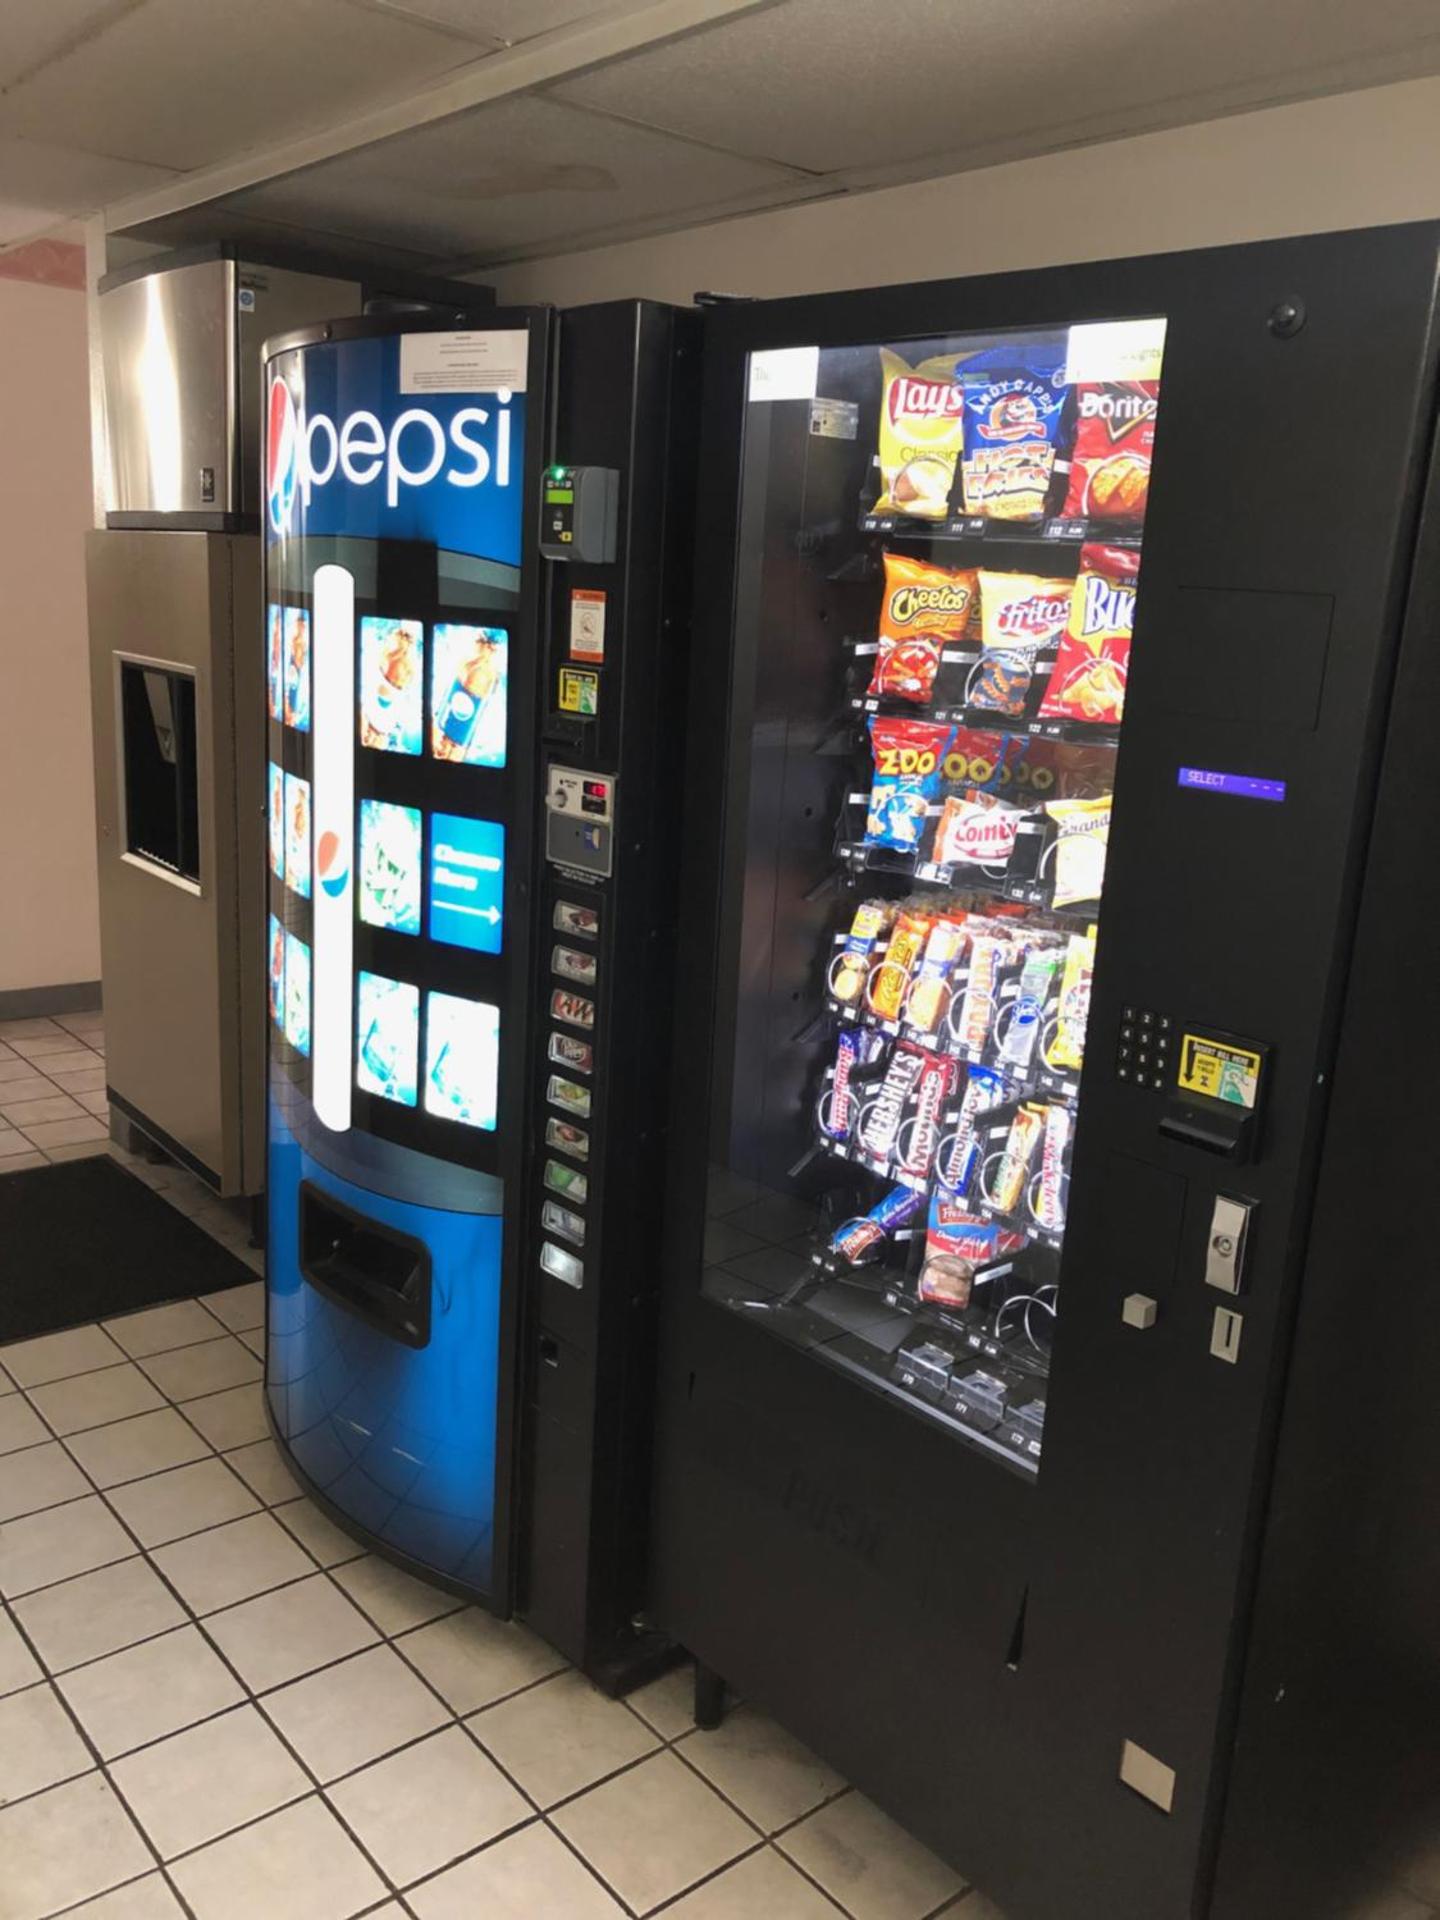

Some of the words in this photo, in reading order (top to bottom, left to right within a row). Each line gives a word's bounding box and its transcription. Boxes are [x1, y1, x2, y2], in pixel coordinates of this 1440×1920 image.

[302, 387, 512, 507] pepsi
[892, 586, 971, 624] Cheetos
[877, 749, 936, 777] ZOO
[1187, 769, 1226, 786] SELECT
[863, 1051, 918, 1147] HERSHEY'S
